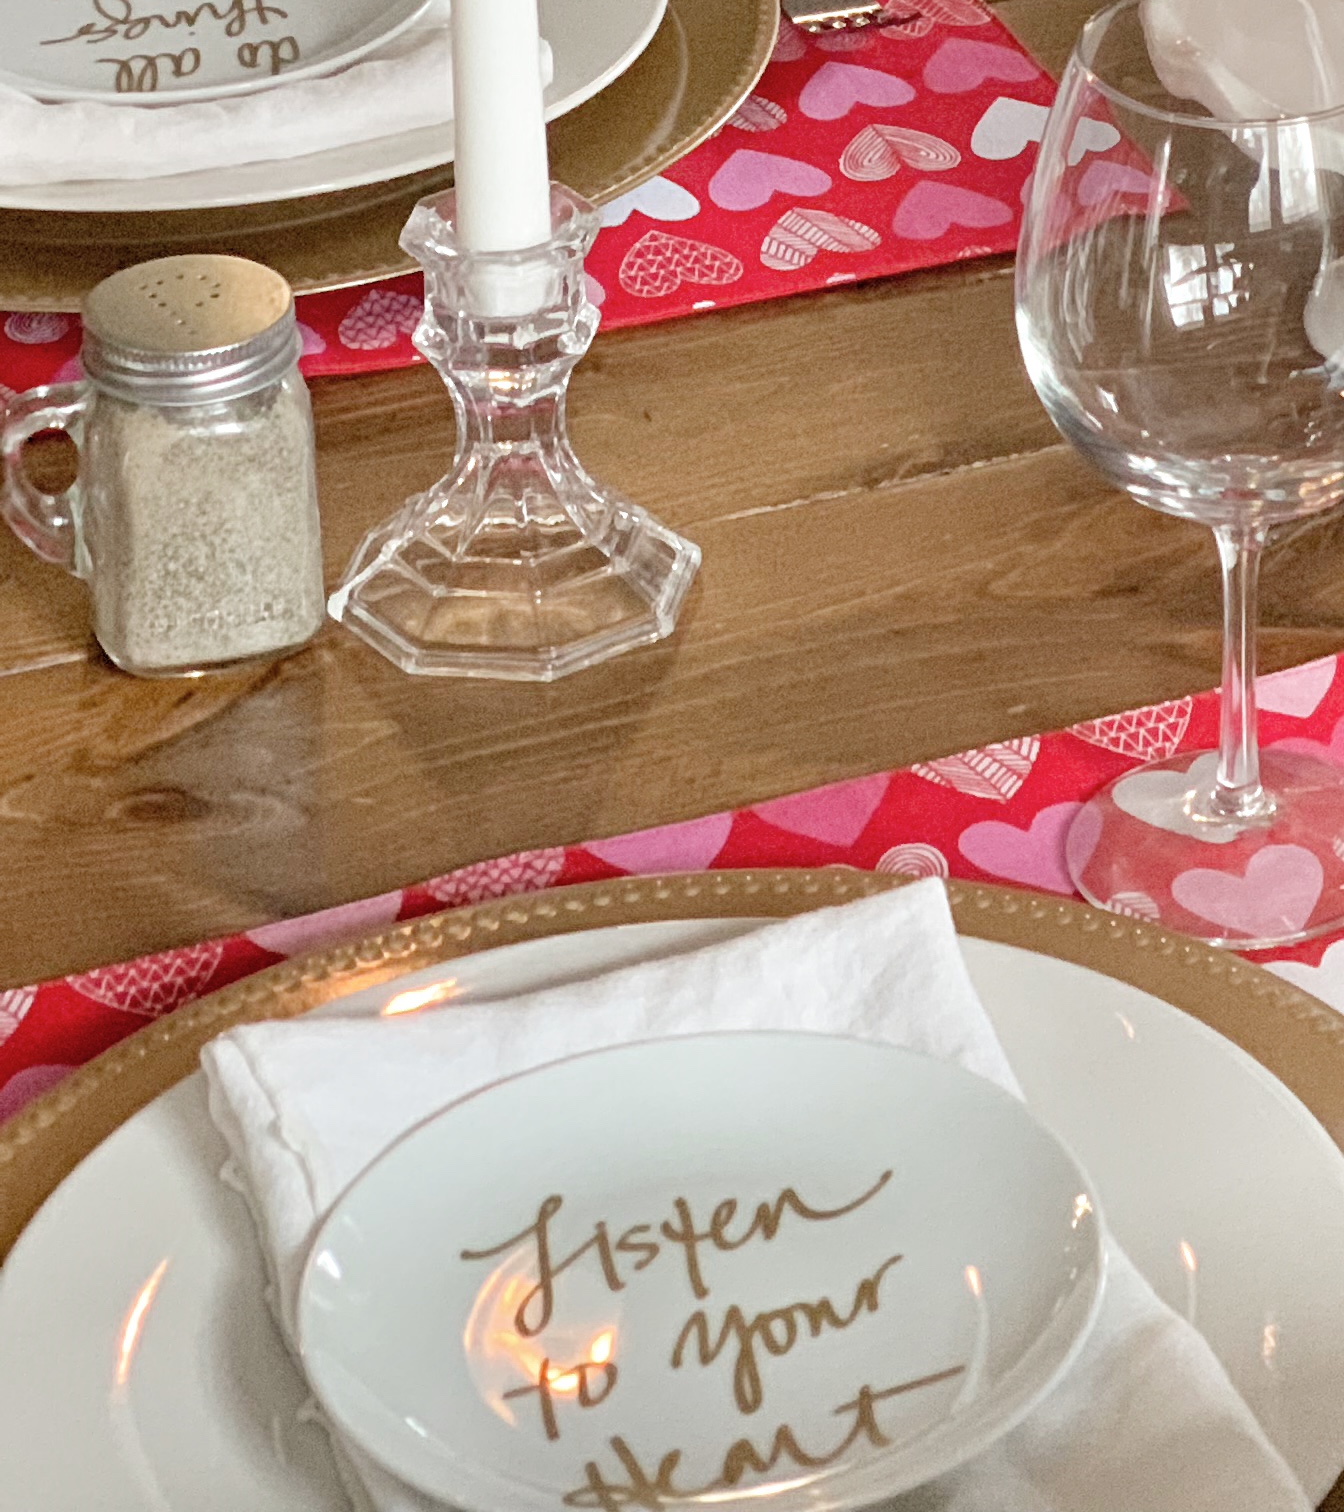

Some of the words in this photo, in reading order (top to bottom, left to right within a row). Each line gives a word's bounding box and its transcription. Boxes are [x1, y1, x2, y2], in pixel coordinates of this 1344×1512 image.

[96, 47, 200, 93] all
[237, 36, 300, 75] do
[461, 1170, 893, 1336] Listen
[502, 1358, 618, 1440] to
[671, 1254, 904, 1414] your
